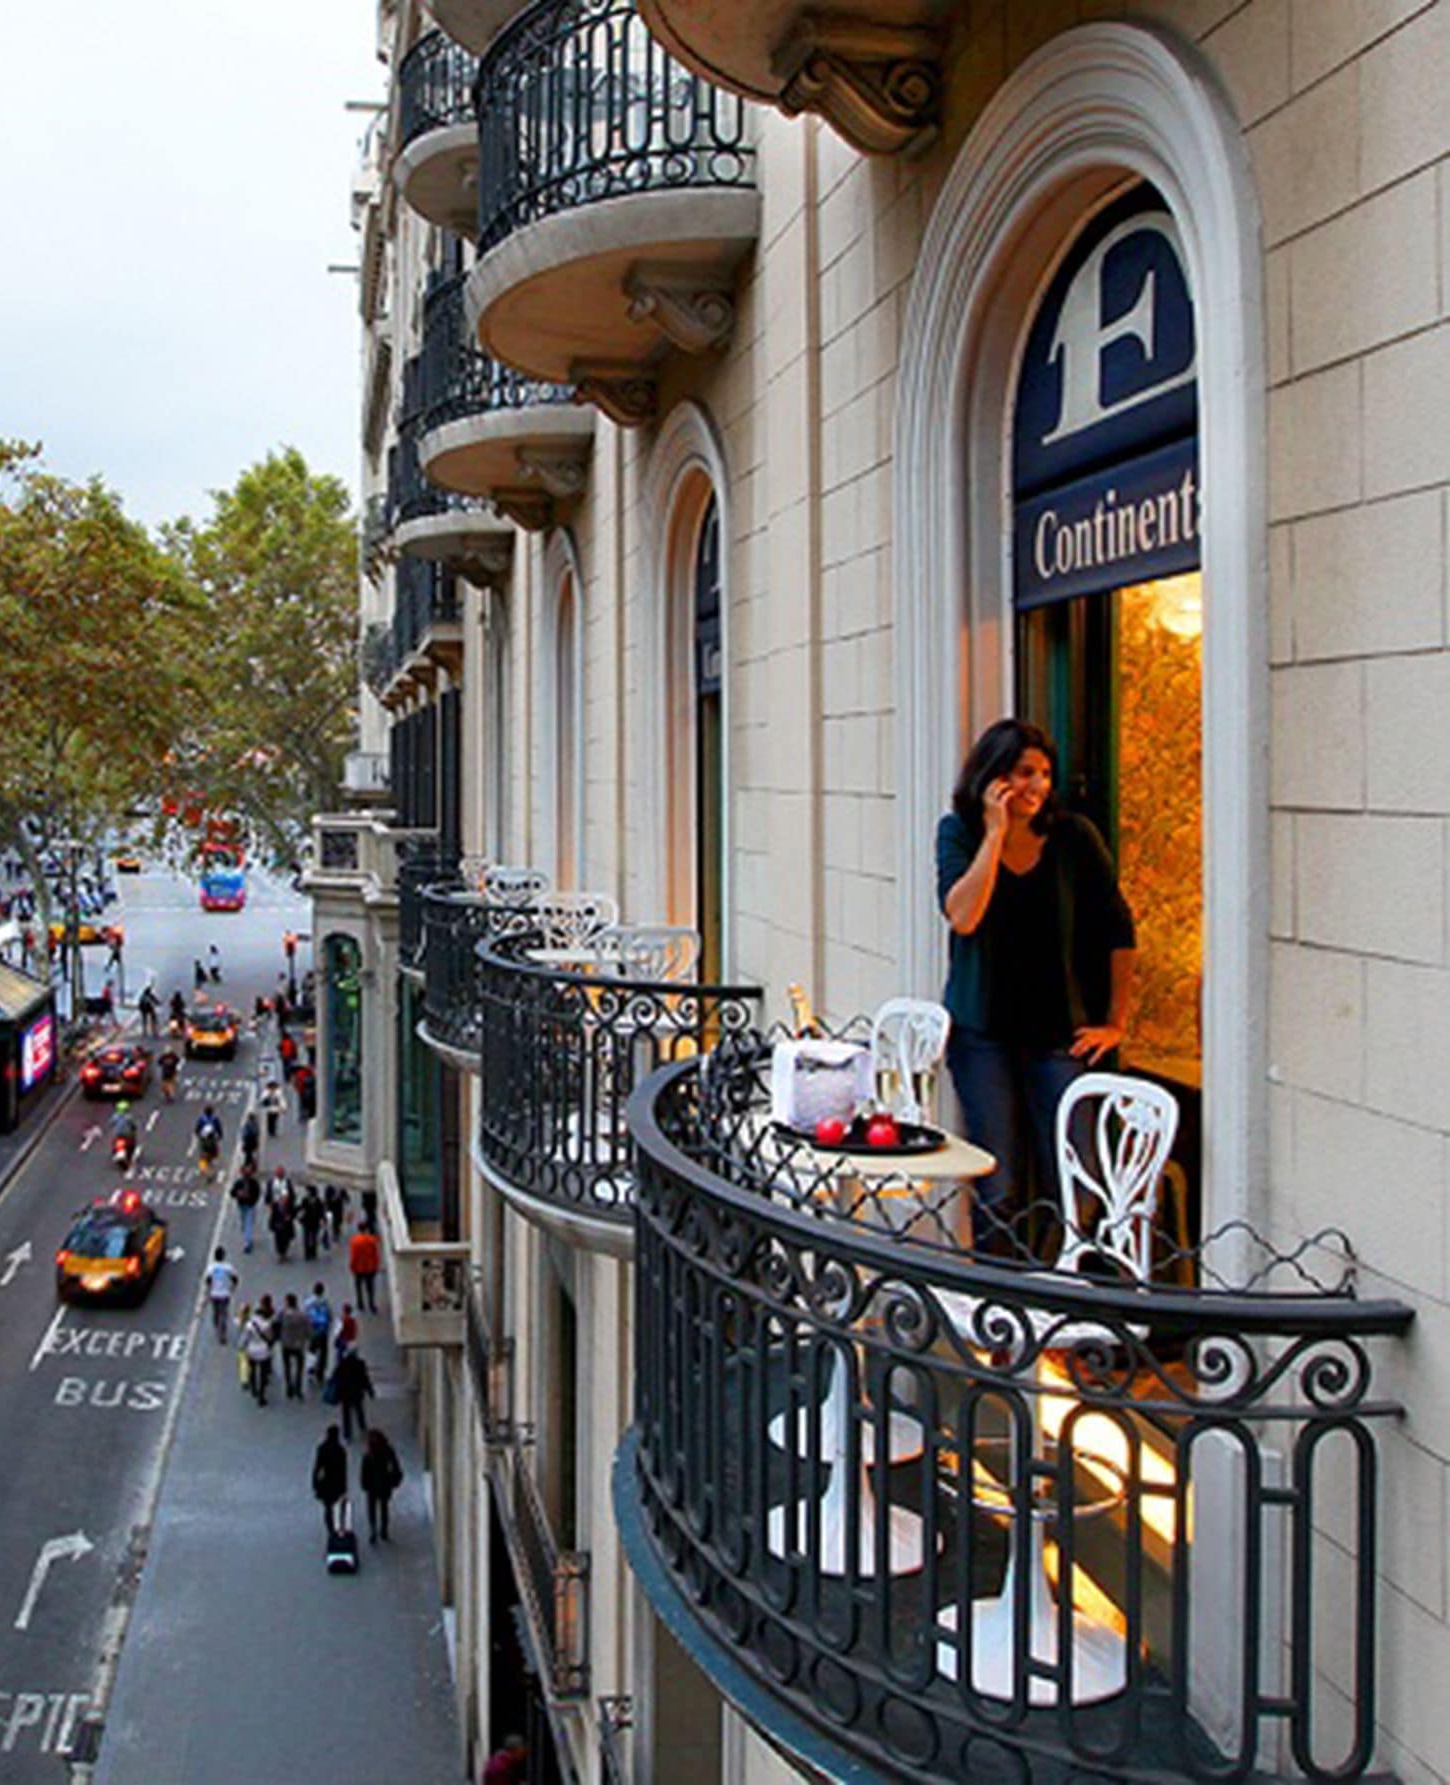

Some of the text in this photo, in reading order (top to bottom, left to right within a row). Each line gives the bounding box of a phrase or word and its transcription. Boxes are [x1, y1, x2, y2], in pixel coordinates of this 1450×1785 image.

[1034, 468, 1204, 580] Continent
[44, 1327, 188, 1362] EXCEPTE
[53, 1376, 167, 1411] BUS
